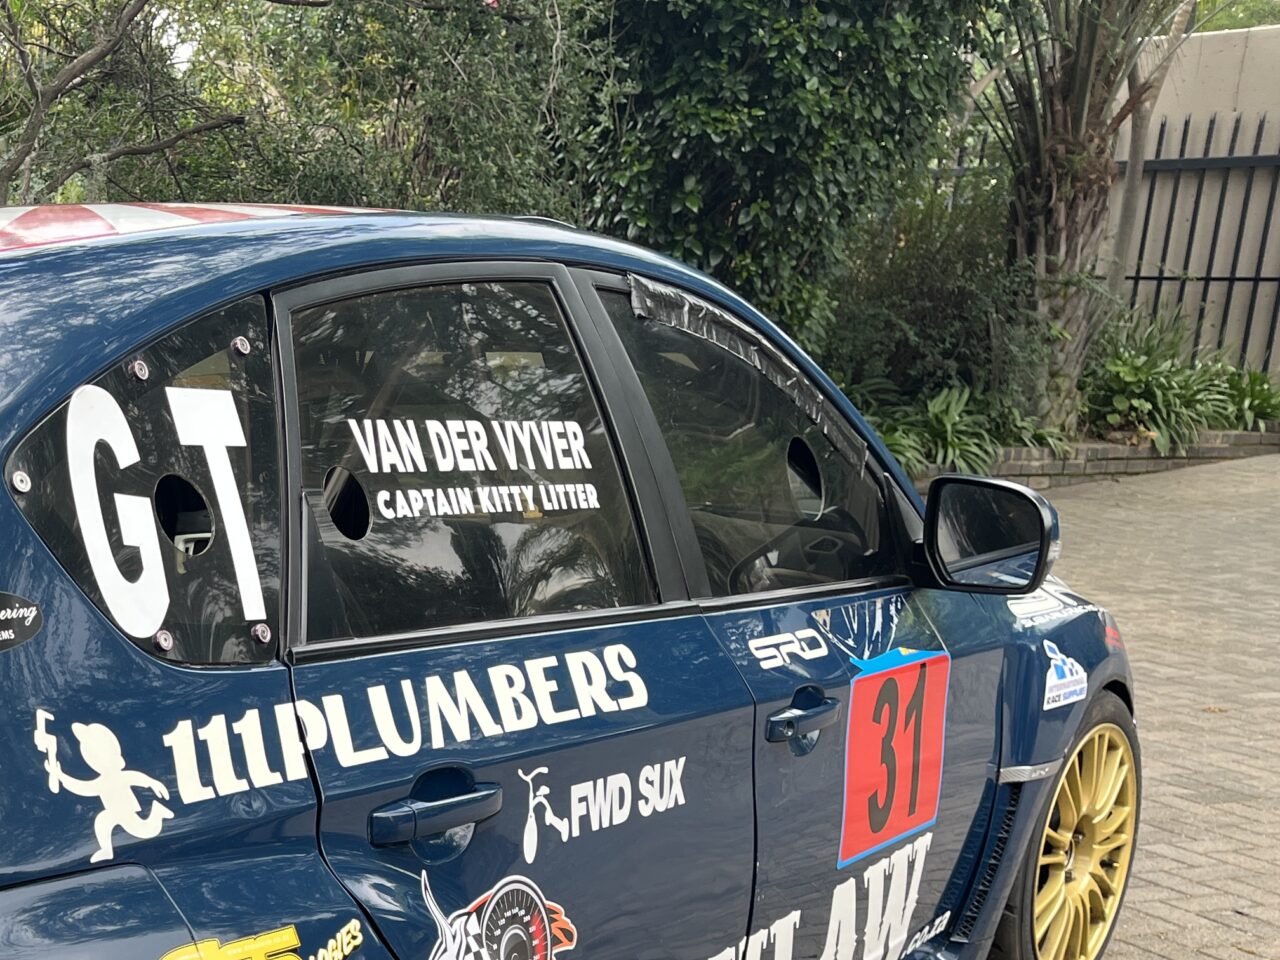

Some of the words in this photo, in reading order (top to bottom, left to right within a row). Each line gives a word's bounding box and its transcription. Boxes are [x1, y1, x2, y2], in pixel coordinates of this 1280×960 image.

[347, 418, 428, 473] VAN
[425, 419, 497, 472] DER
[491, 420, 593, 471] VYVER
[65, 384, 267, 640] GT
[376, 488, 476, 520] CAPTAIN
[477, 485, 537, 515] KITTY
[538, 483, 601, 511] LITTER
[867, 661, 928, 834] 31
[570, 772, 632, 838] FWD
[637, 756, 687, 818] SUX
